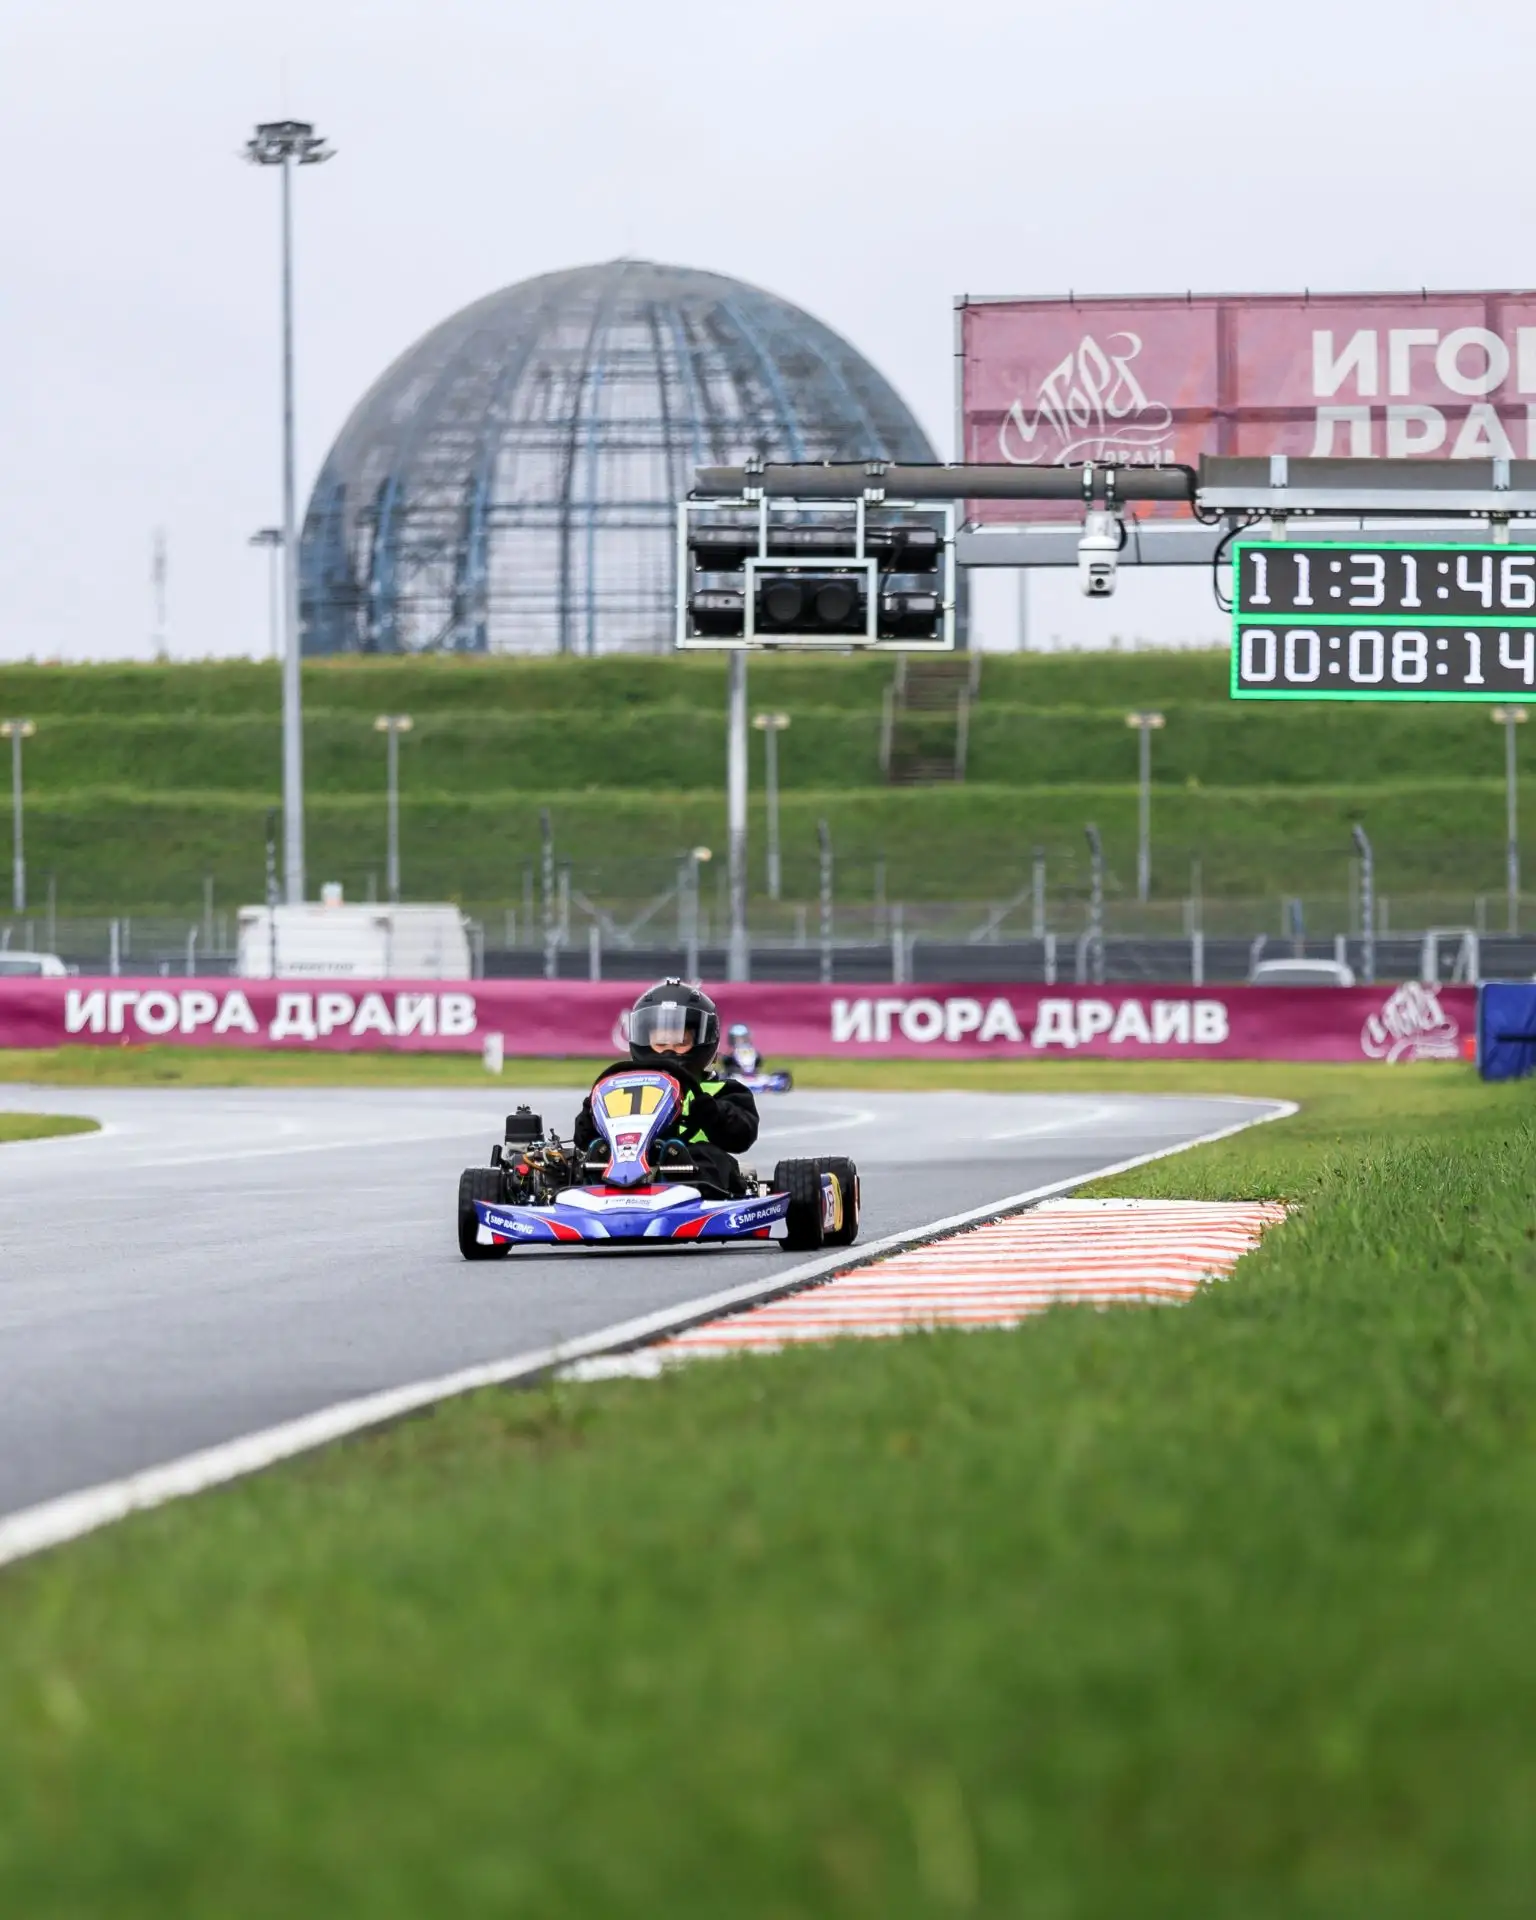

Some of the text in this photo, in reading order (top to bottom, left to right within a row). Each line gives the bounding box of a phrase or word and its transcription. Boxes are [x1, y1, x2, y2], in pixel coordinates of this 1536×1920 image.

[1309, 403, 1536, 460] ДРА
[1249, 553, 1536, 608] 11:31:46
[1240, 629, 1536, 685] 00:08:14
[64, 989, 259, 1034] ИГОРА
[830, 997, 1024, 1043] ИГОРА
[623, 1086, 643, 1115] 1
[503, 1219, 534, 1234] RACING
[738, 1205, 781, 1224] SMP RACING
